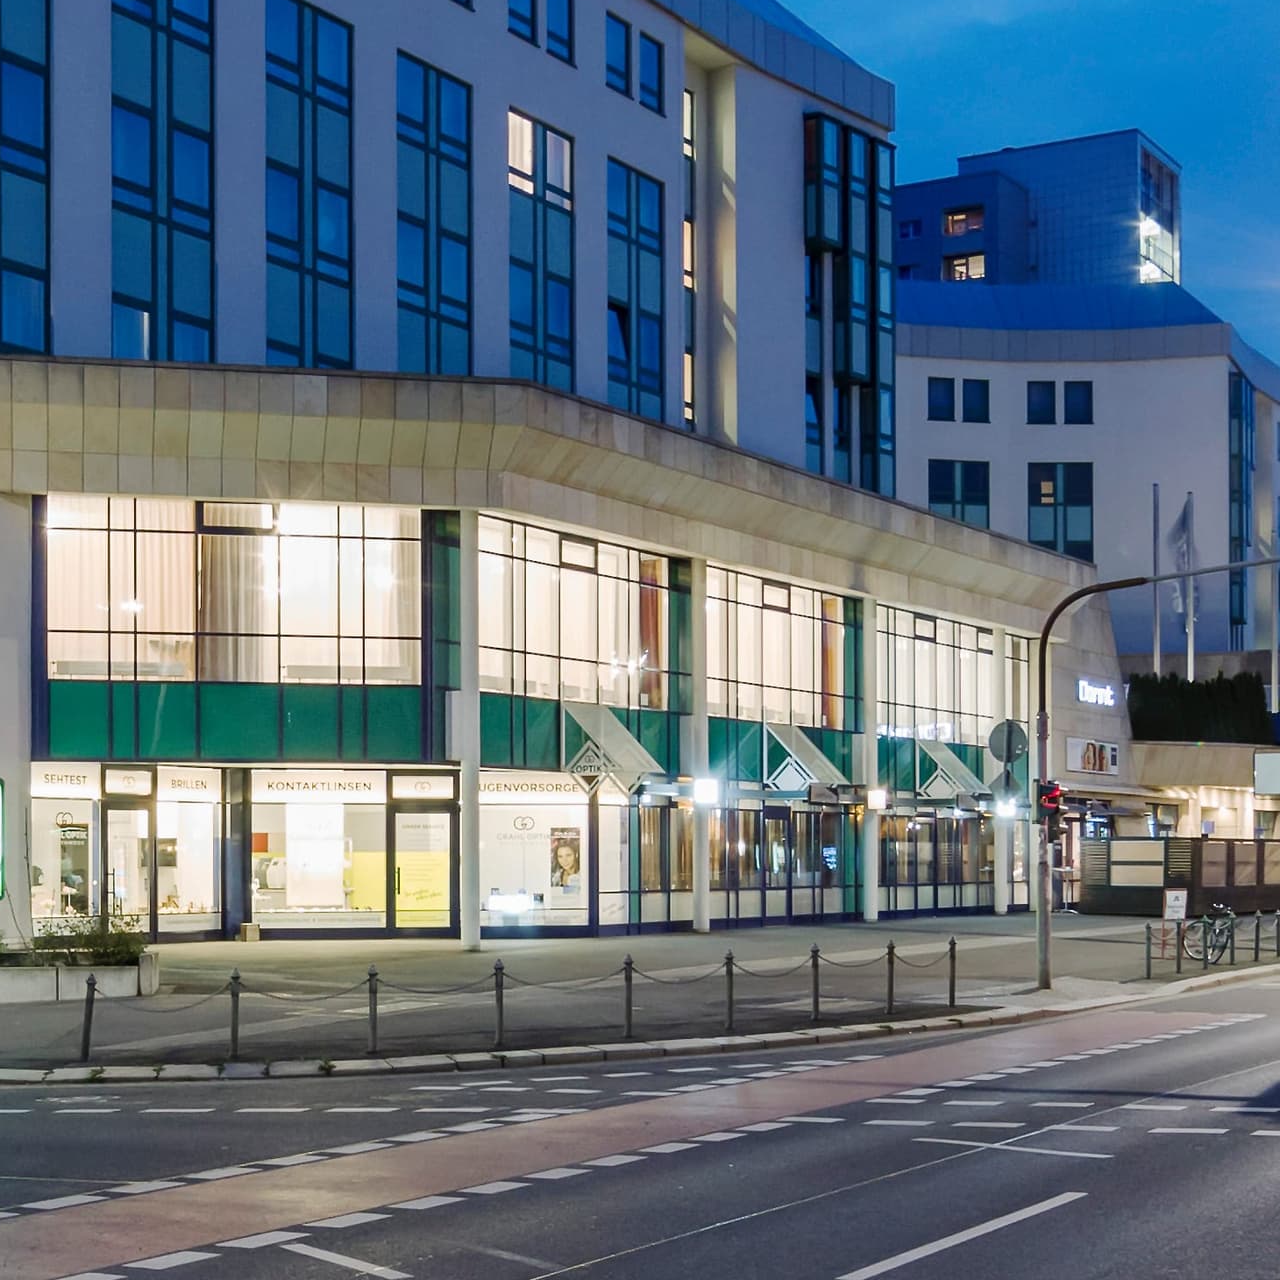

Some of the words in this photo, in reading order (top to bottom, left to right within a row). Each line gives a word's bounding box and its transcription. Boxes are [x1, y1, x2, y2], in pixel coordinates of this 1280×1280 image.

[575, 764, 602, 774] OPTIK
[44, 773, 87, 786] SEHTEST
[171, 779, 208, 790] BRILLEN
[267, 781, 372, 792] KONTAKTLINSEN
